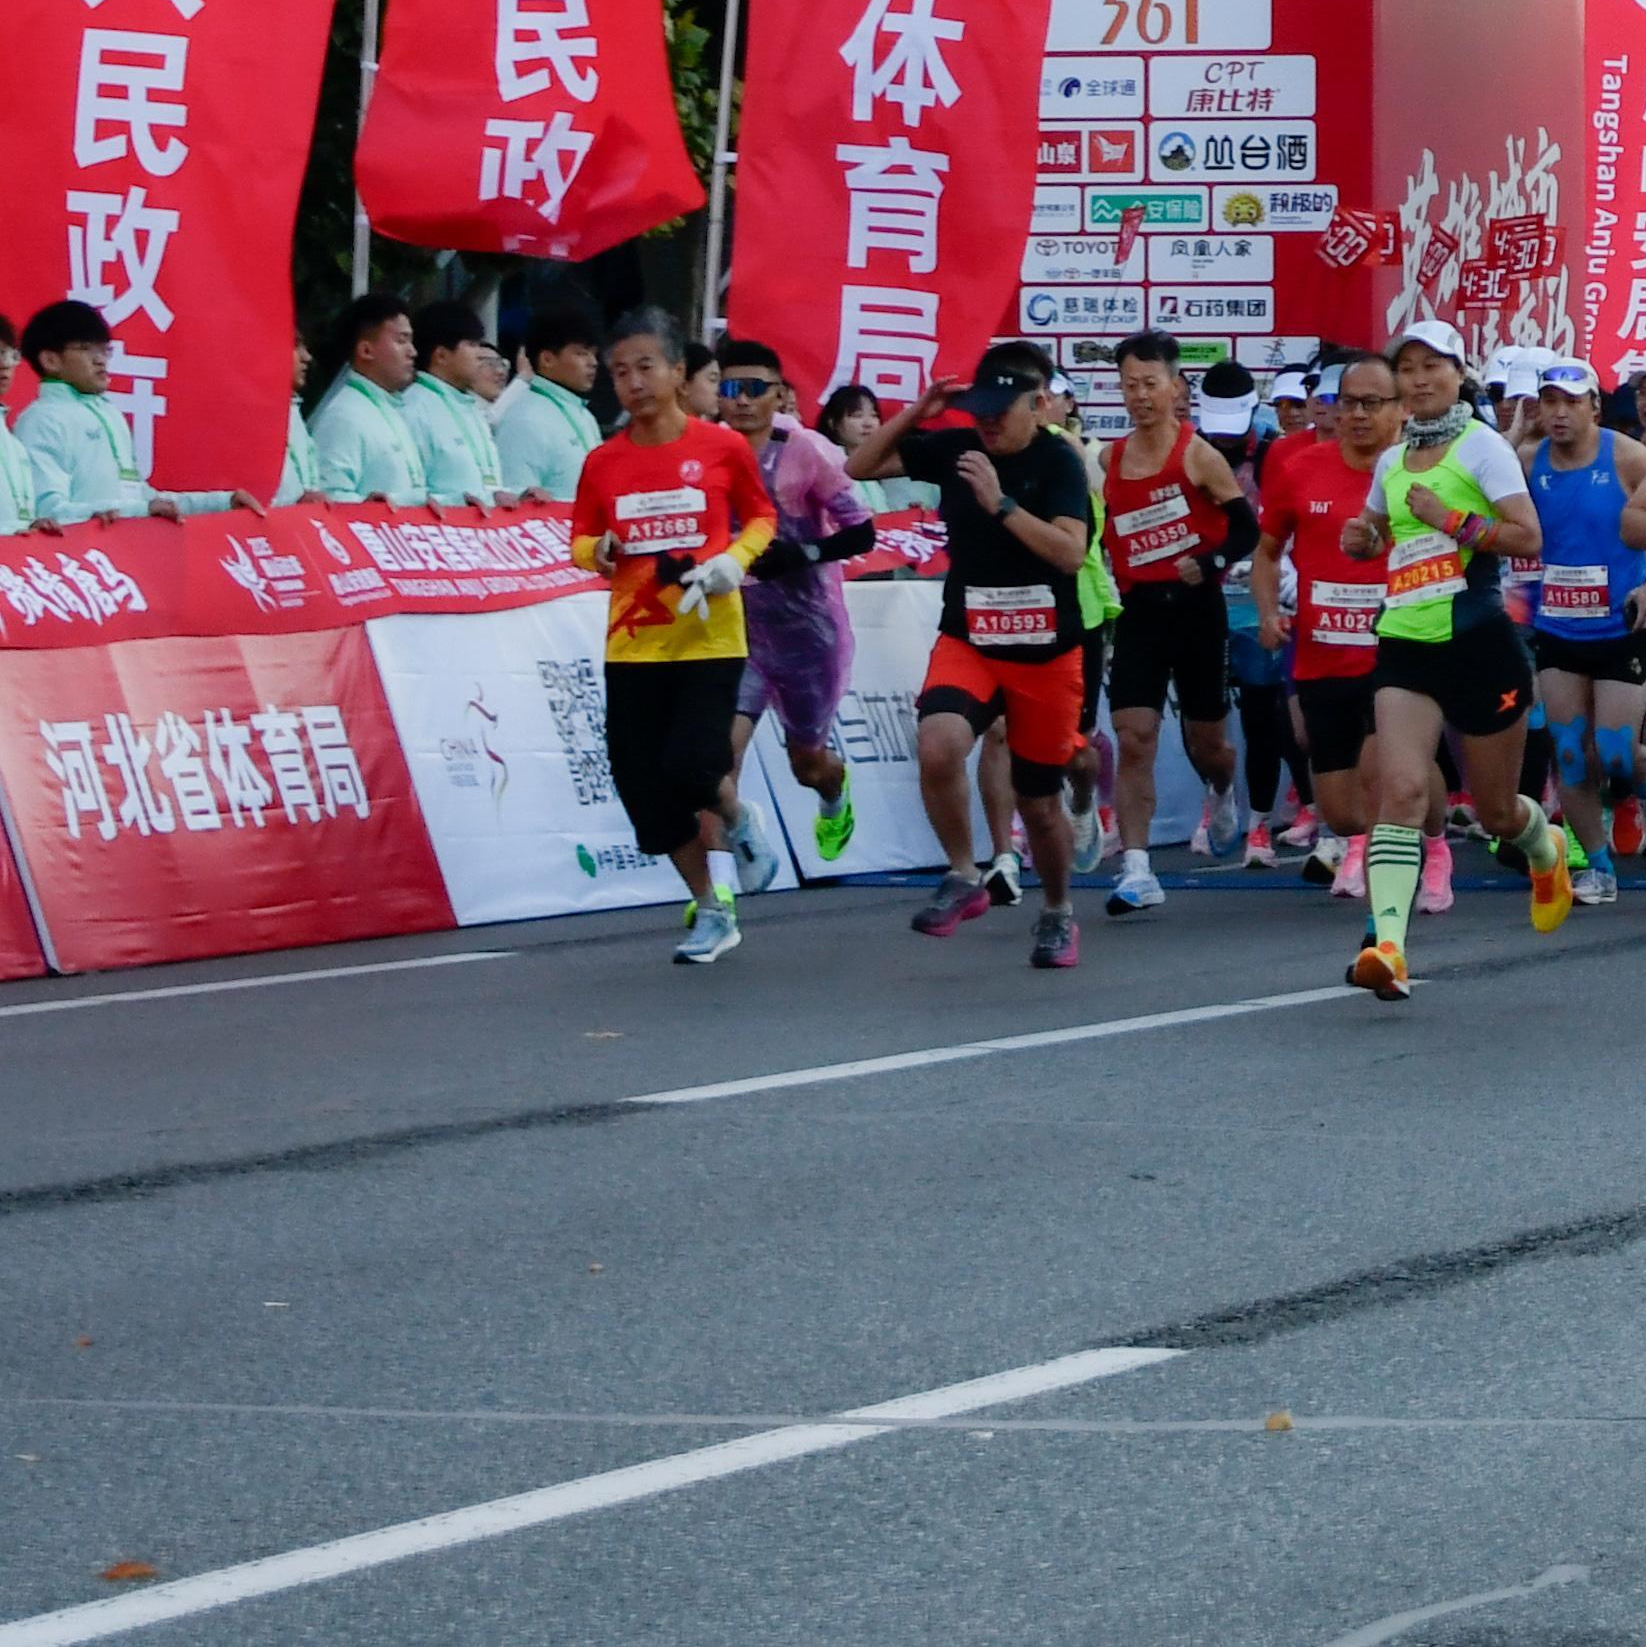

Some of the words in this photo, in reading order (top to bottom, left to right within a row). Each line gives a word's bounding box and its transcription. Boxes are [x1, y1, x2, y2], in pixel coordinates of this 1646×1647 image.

[1204, 60, 1265, 85] CPT
[1086, 79, 1136, 97] 全球通
[1186, 87, 1275, 114] 康比特
[1593, 54, 1629, 202] Tangshan
[1203, 134, 1309, 171] 丛台酒
[1269, 192, 1333, 214] 积极的
[1063, 241, 1120, 255] TOYOT
[1170, 239, 1252, 258] 凤凰人家
[1584, 208, 1620, 276] Anju
[1184, 298, 1267, 317] 石药集团
[1129, 522, 1188, 553] A10350
[1393, 560, 1455, 591] A20215
[1546, 590, 1601, 605] A11580
[976, 613, 1047, 630] A10593
[1319, 612, 1375, 629] A102
[38, 704, 371, 841] 河北省体育局
